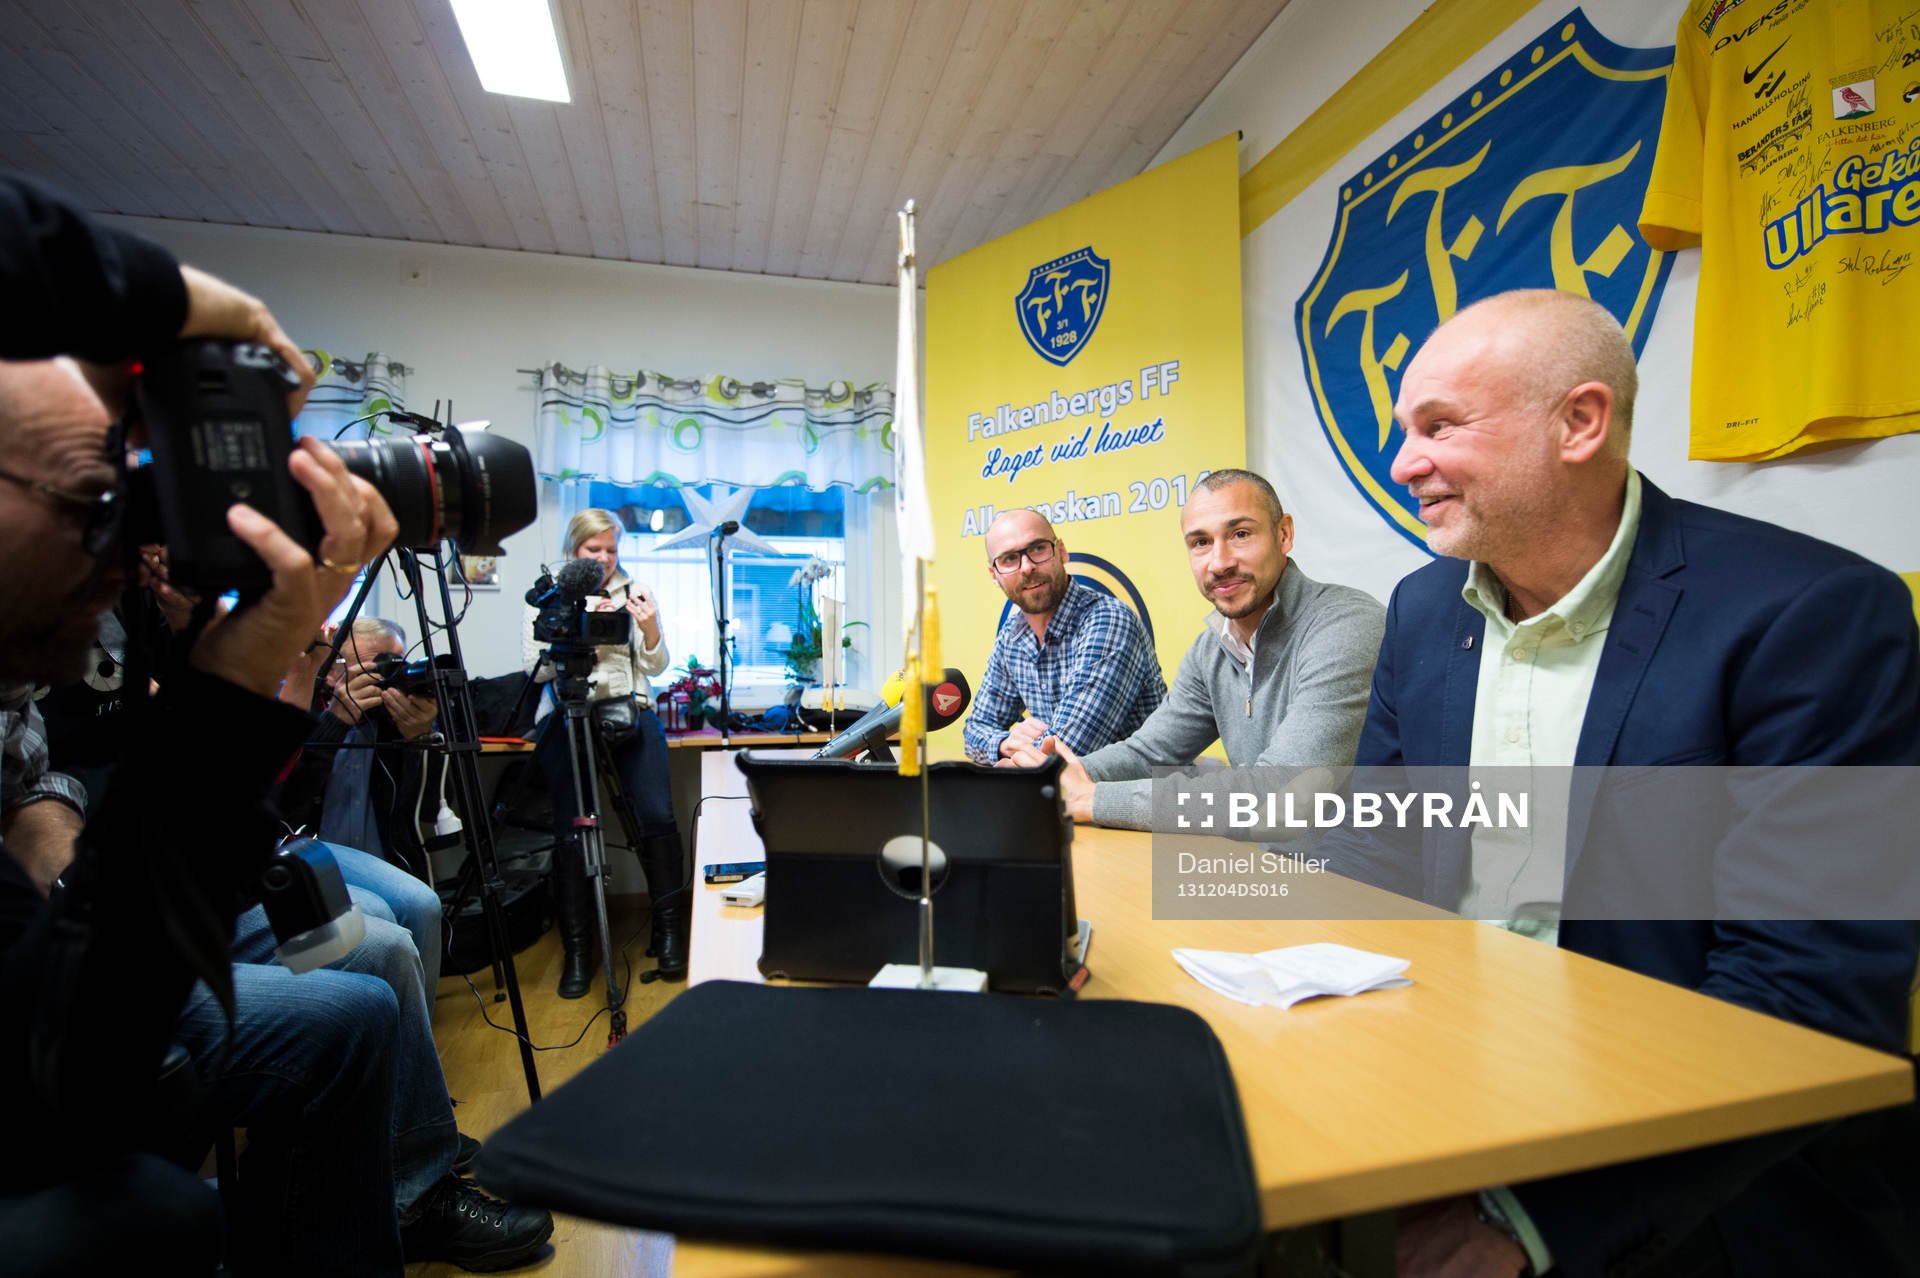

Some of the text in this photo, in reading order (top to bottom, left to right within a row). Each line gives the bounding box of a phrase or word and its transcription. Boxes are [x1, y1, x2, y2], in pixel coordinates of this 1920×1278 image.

[1817, 116, 1896, 144] FALKENBERG
[1050, 330, 1077, 349] 1928
[967, 360, 1180, 442] Falkenbergs FF
[1726, 417, 1760, 429] DRI-FIT
[981, 417, 1166, 484] Laget vid havet
[961, 490, 1122, 537] Allnskan
